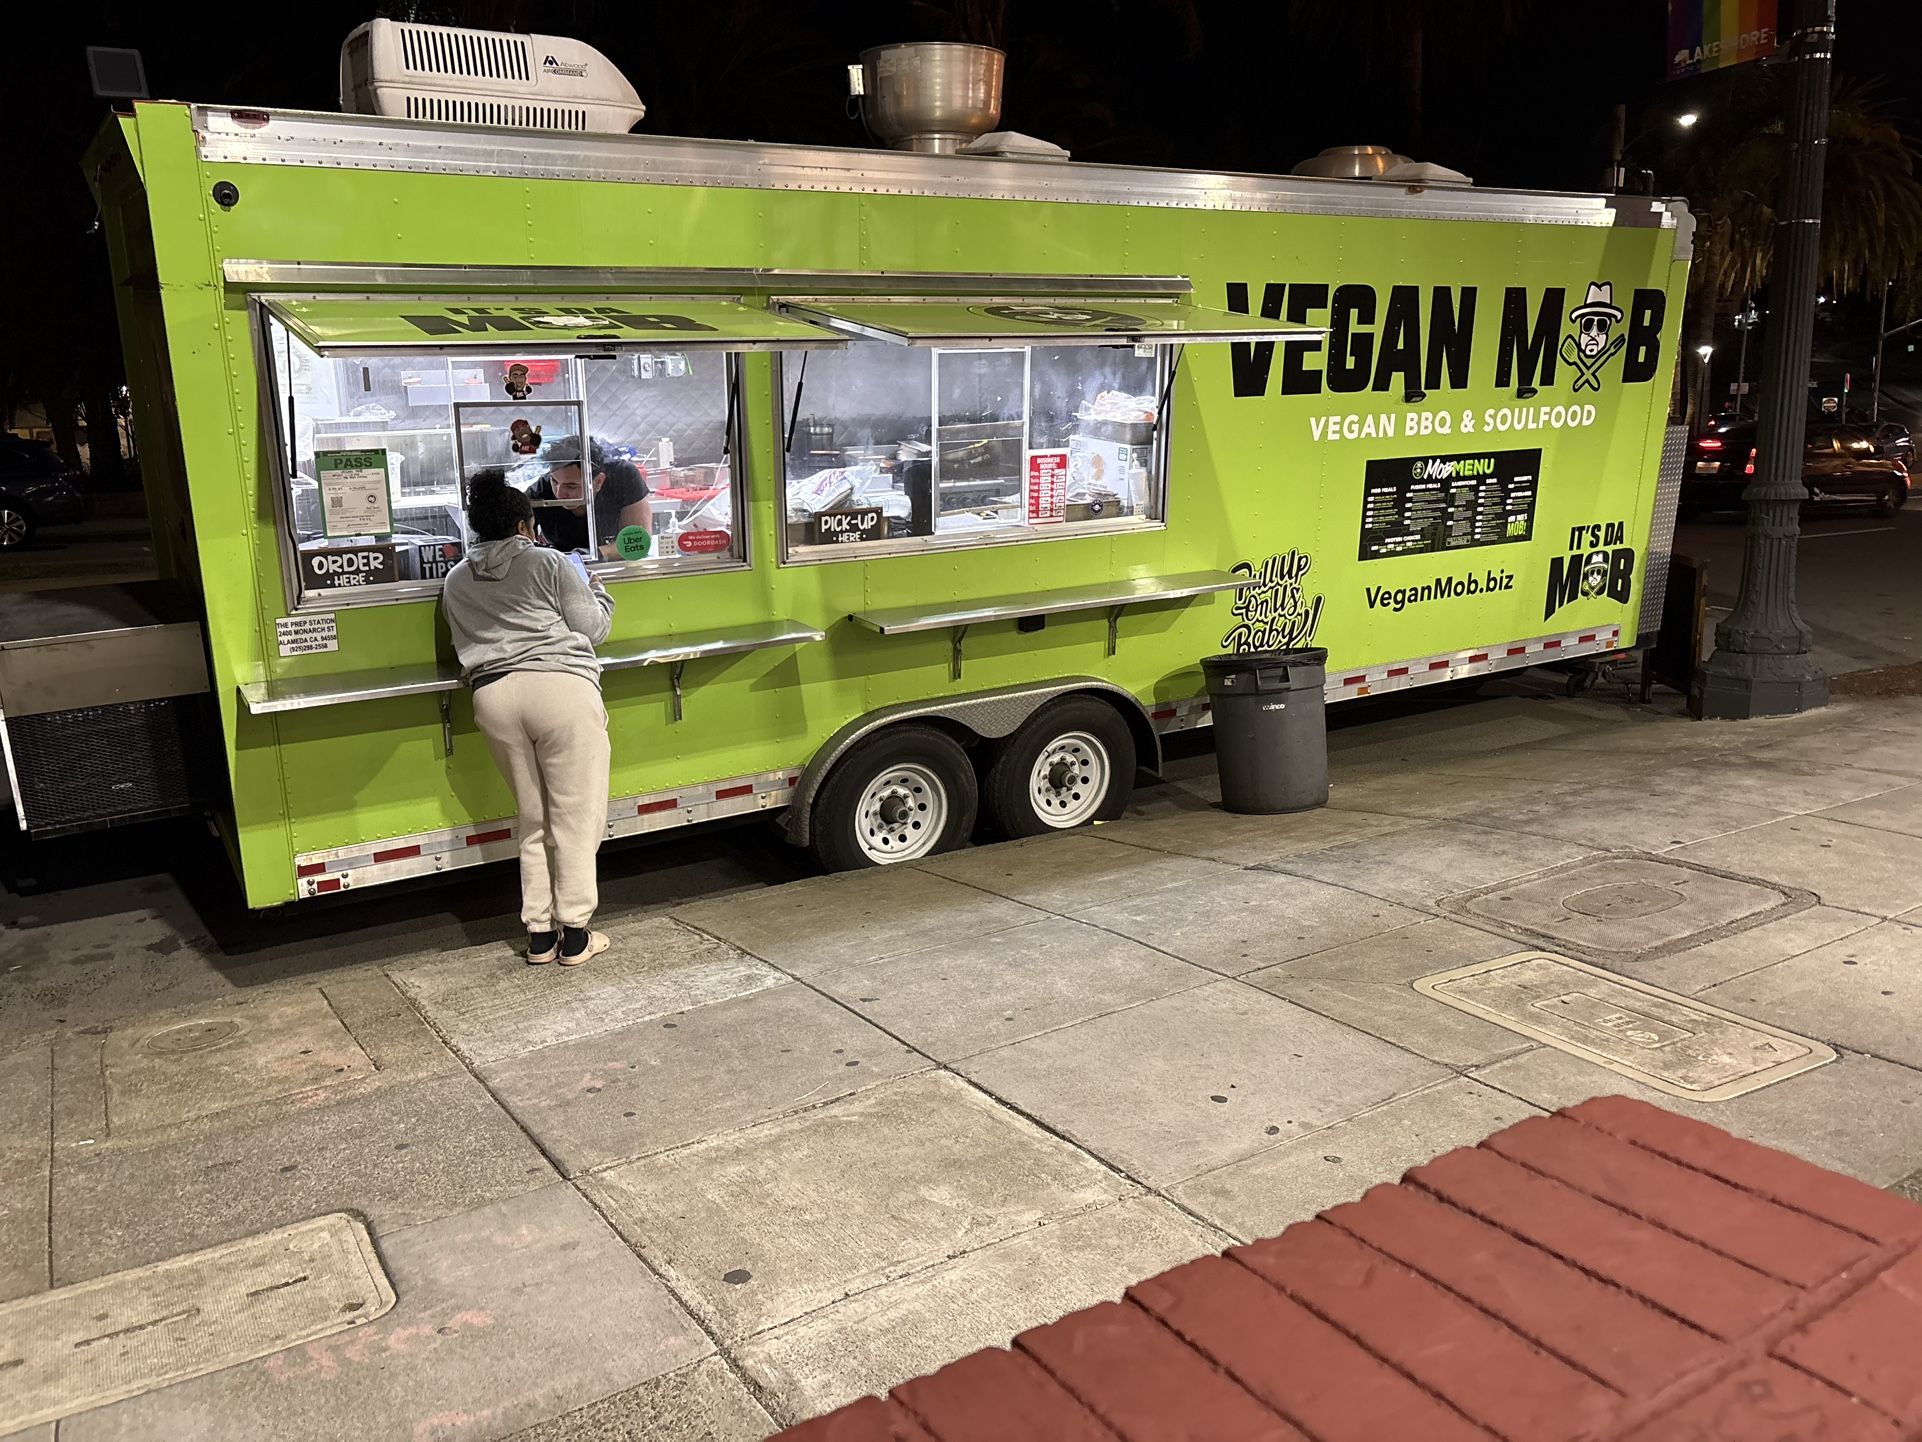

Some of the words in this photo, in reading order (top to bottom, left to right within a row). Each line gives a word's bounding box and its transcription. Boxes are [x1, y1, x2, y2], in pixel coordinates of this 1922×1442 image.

[1687, 28, 1769, 63] LAKEORE
[444, 307, 537, 315] IT'S
[554, 307, 633, 315] DA
[1226, 282, 1478, 398] VEGAN
[1495, 284, 1667, 391] MB
[1309, 413, 1396, 442] VEGAN
[1404, 410, 1452, 436] BBQ
[1460, 408, 1476, 433] &
[1482, 404, 1597, 432] SOULFOOD
[333, 456, 373, 469] PASS
[821, 512, 878, 533] PICK-UP
[624, 536, 643, 545] Uber
[693, 539, 727, 547] DOORDASH
[838, 531, 862, 543] HERE
[1569, 523, 1602, 552] IT'S
[1603, 520, 1625, 547] DA
[420, 545, 444, 562] WE
[624, 545, 645, 553] Eats
[311, 551, 384, 575] ORDER
[1278, 547, 1313, 587] Up
[334, 572, 367, 587] HERE
[1544, 547, 1636, 624] MOB
[1365, 568, 1515, 613] VeganMob.biz
[1231, 593, 1270, 624] On
[294, 627, 326, 635] MONARCH
[309, 618, 335, 626] STATION
